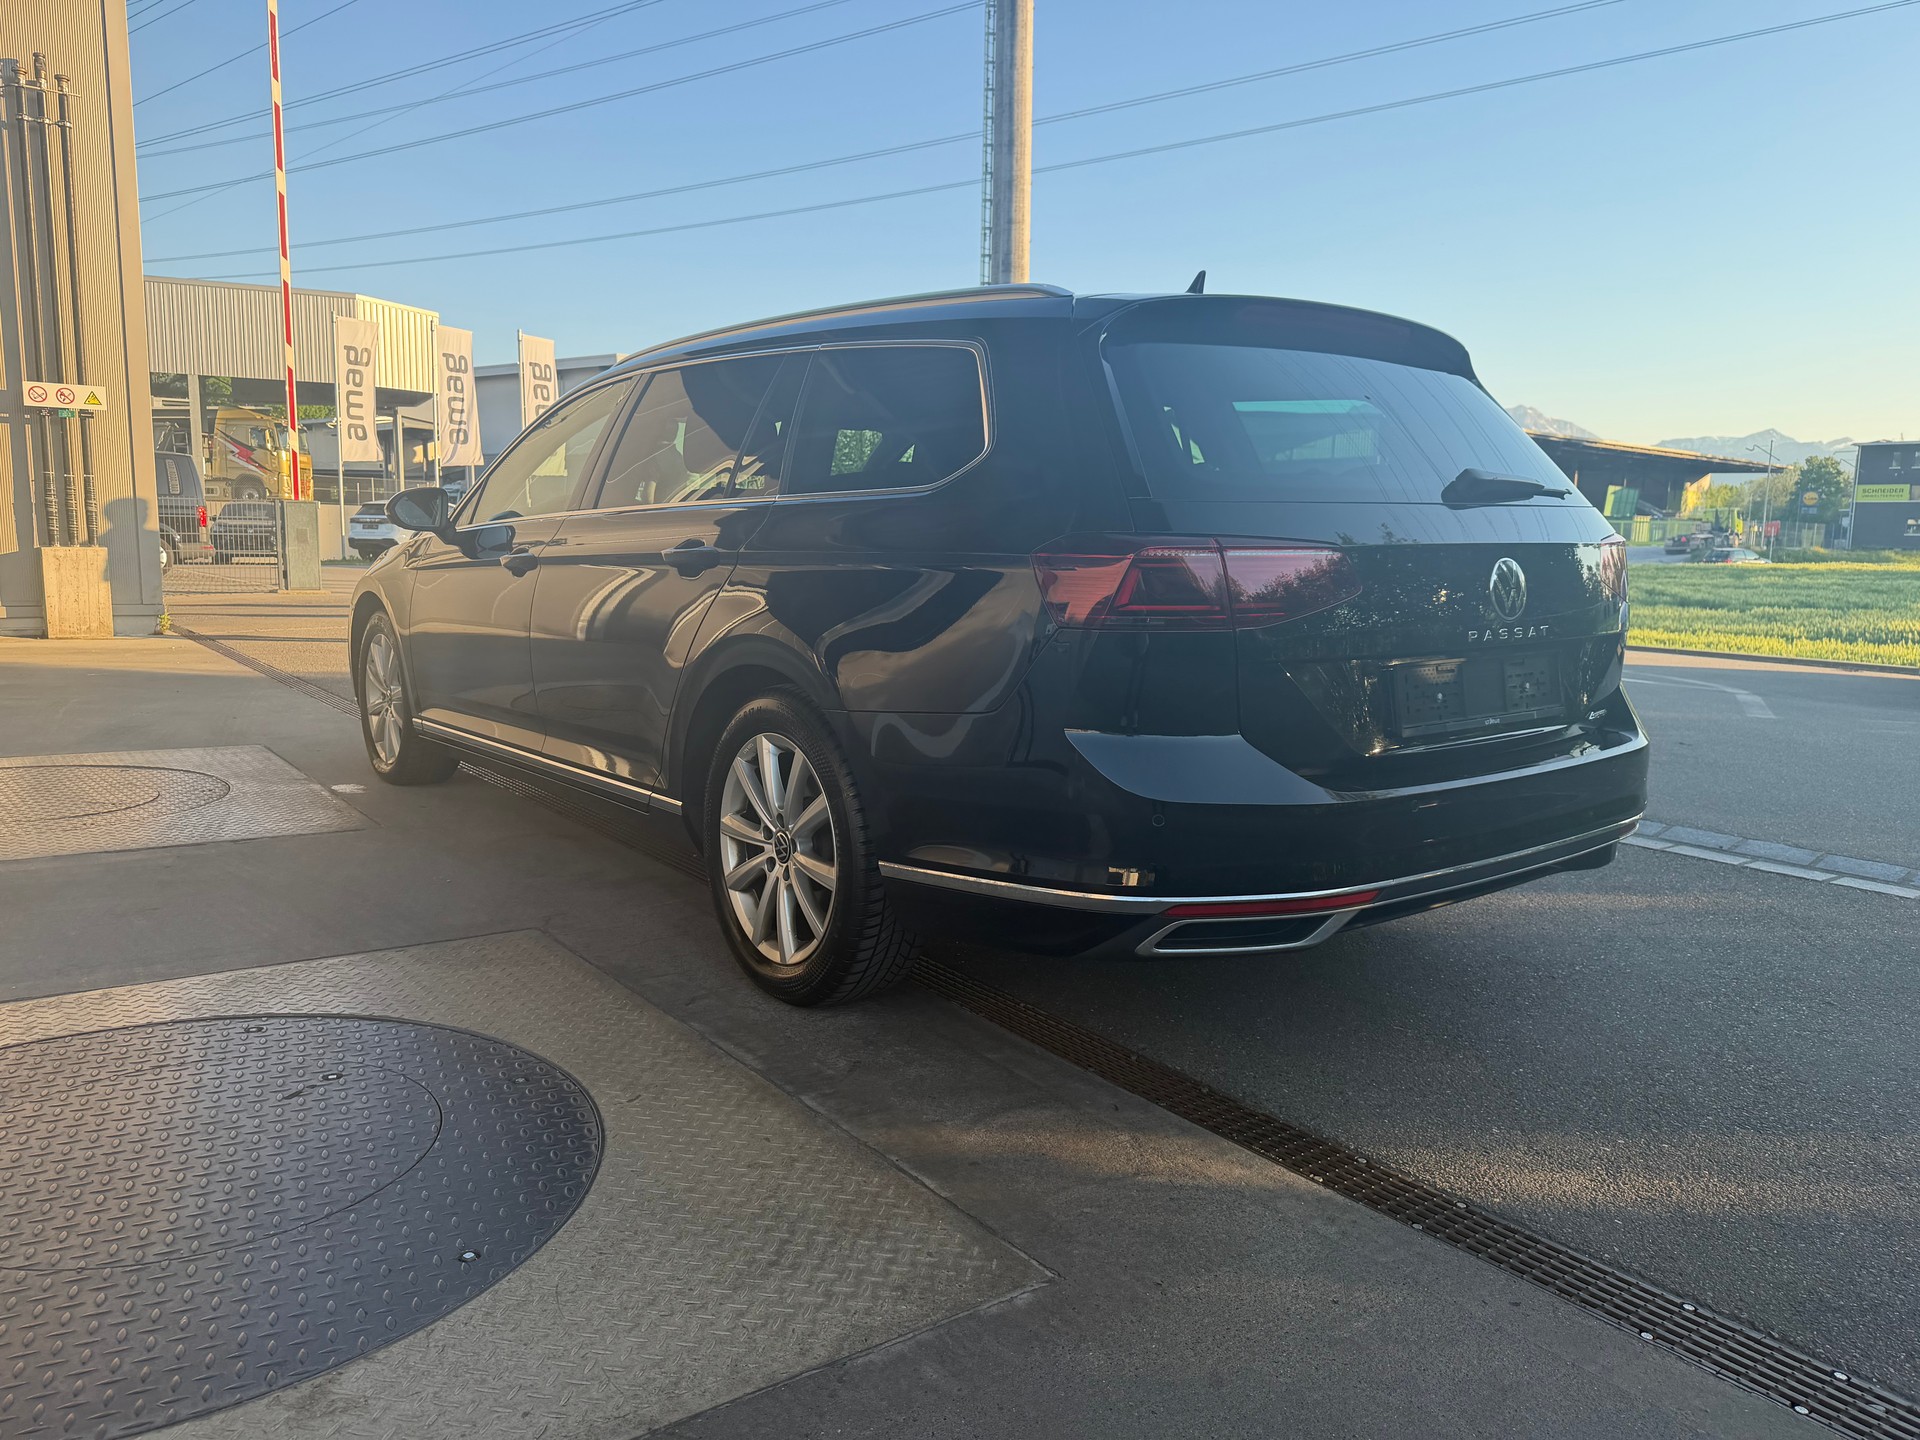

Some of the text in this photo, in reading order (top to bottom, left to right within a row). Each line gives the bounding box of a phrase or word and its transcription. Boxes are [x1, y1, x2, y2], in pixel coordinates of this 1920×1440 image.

[343, 344, 372, 442] amag
[441, 352, 469, 446] amag
[1468, 625, 1549, 642] PASSAT
